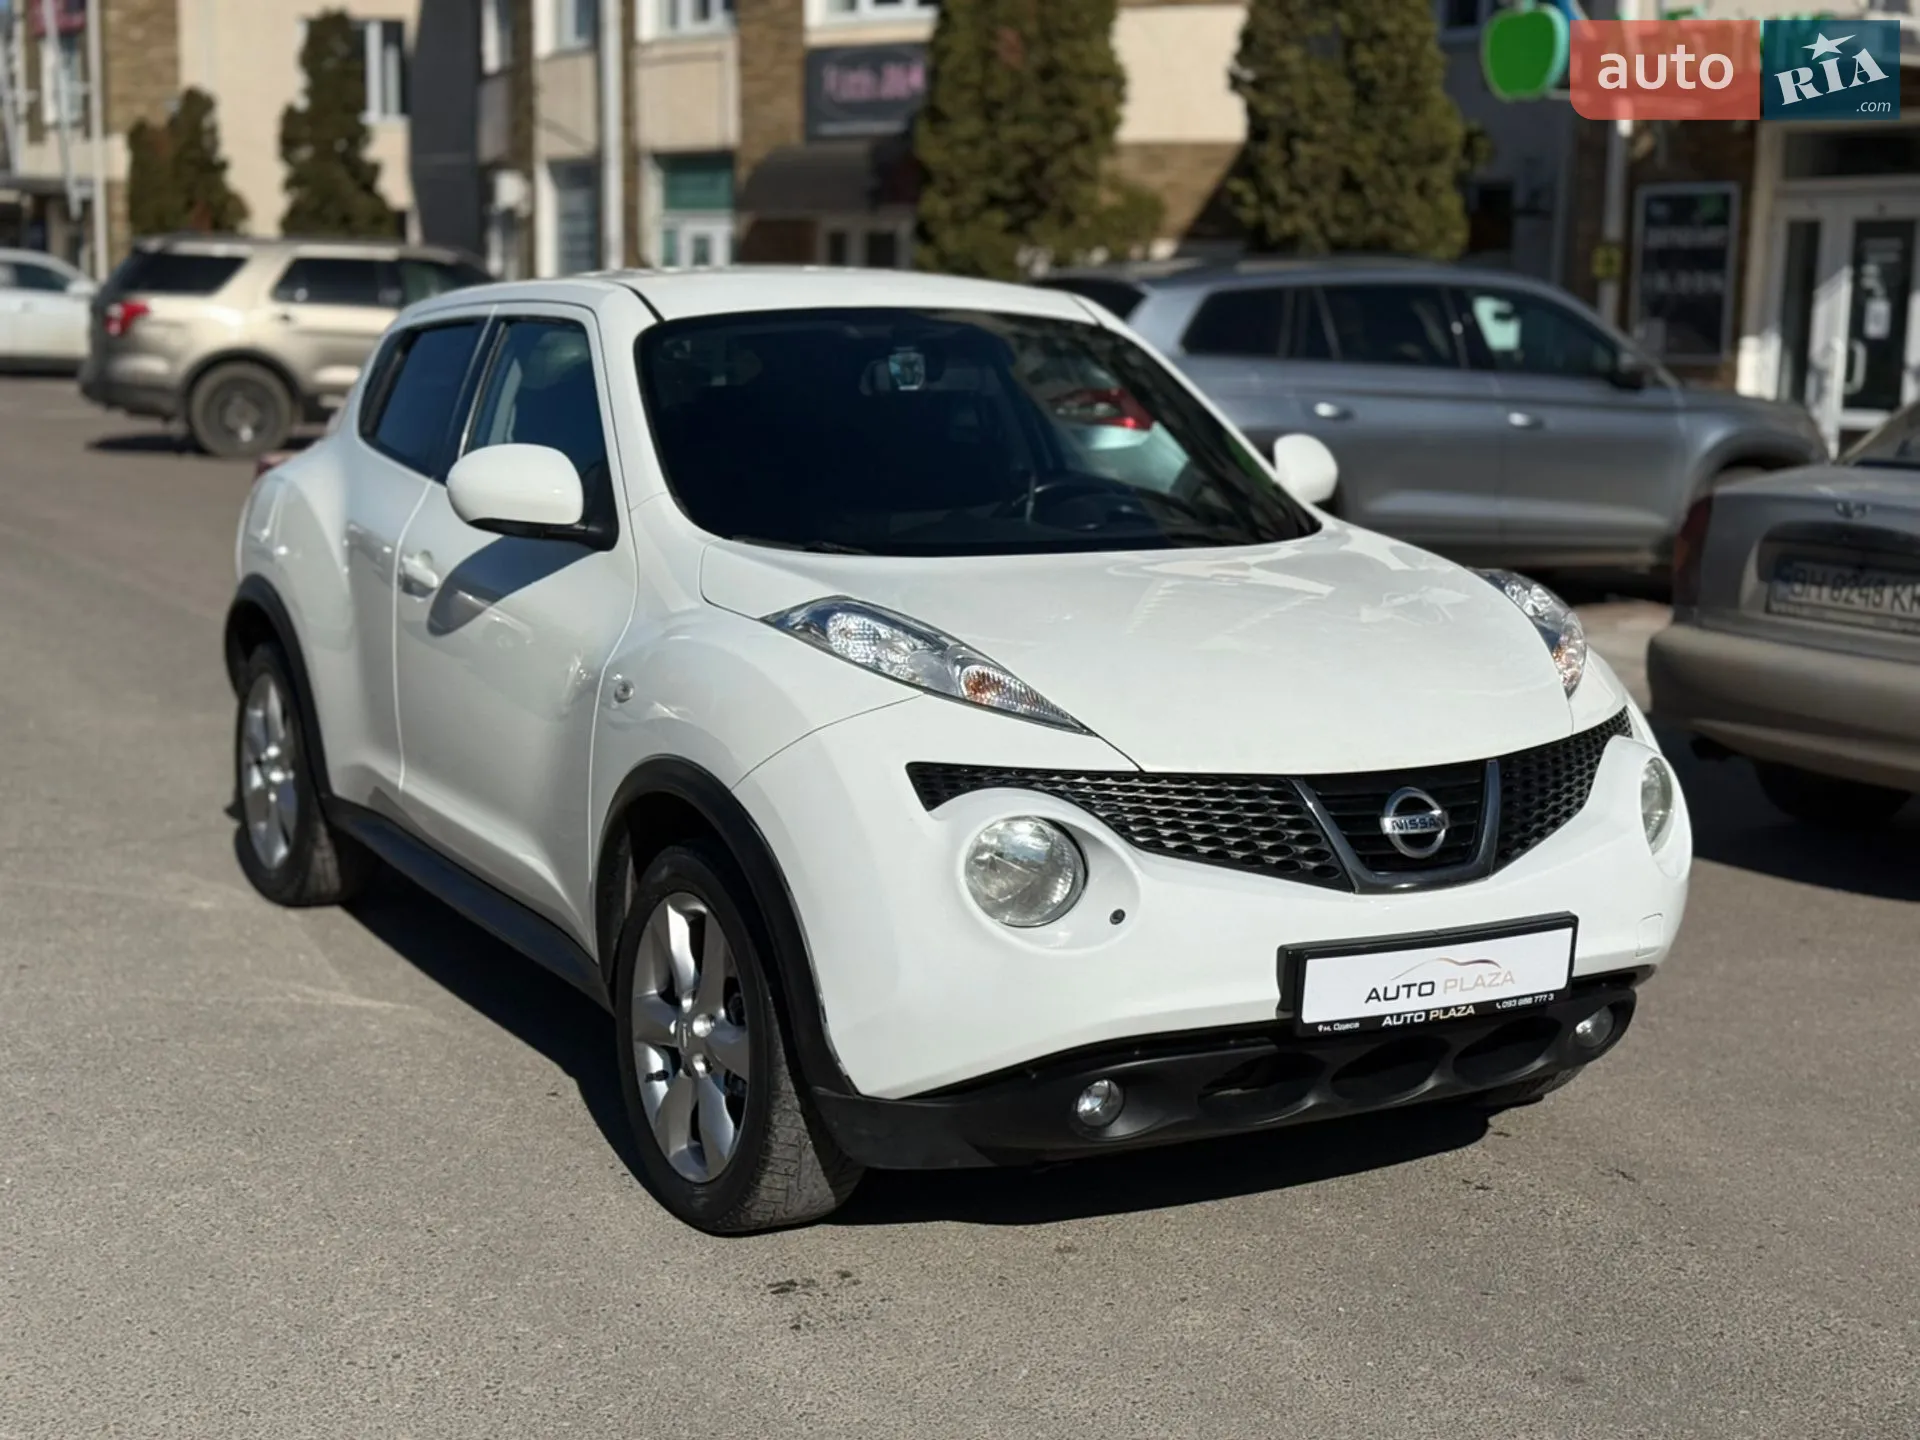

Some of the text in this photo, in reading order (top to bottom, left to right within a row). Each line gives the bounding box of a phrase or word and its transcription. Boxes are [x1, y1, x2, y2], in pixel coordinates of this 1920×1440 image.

[1364, 970, 1515, 1004] AUTO PLAZA
[1382, 1005, 1475, 1027] AUTO PLAZA
